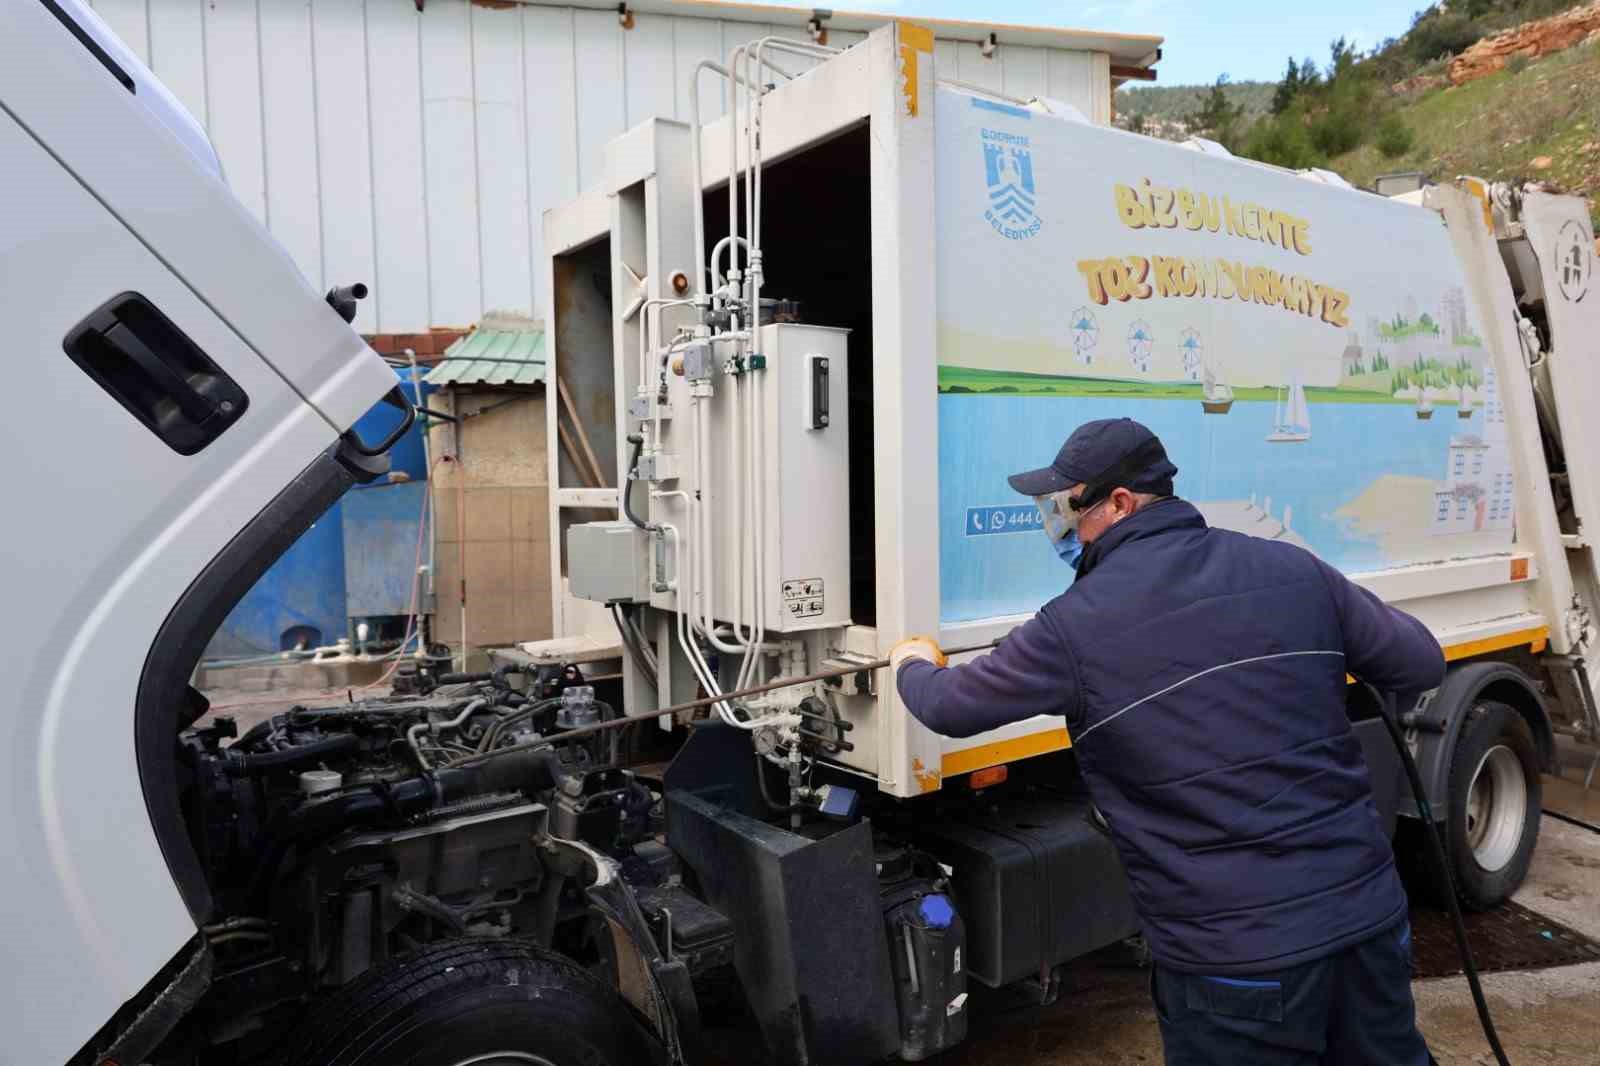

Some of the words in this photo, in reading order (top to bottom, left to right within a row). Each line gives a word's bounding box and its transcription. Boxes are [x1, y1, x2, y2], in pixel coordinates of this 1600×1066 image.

[1114, 177, 1178, 229] BİZ
[1176, 190, 1221, 233] BU
[1077, 254, 1153, 306] TOZ
[1008, 511, 1032, 525] 444
